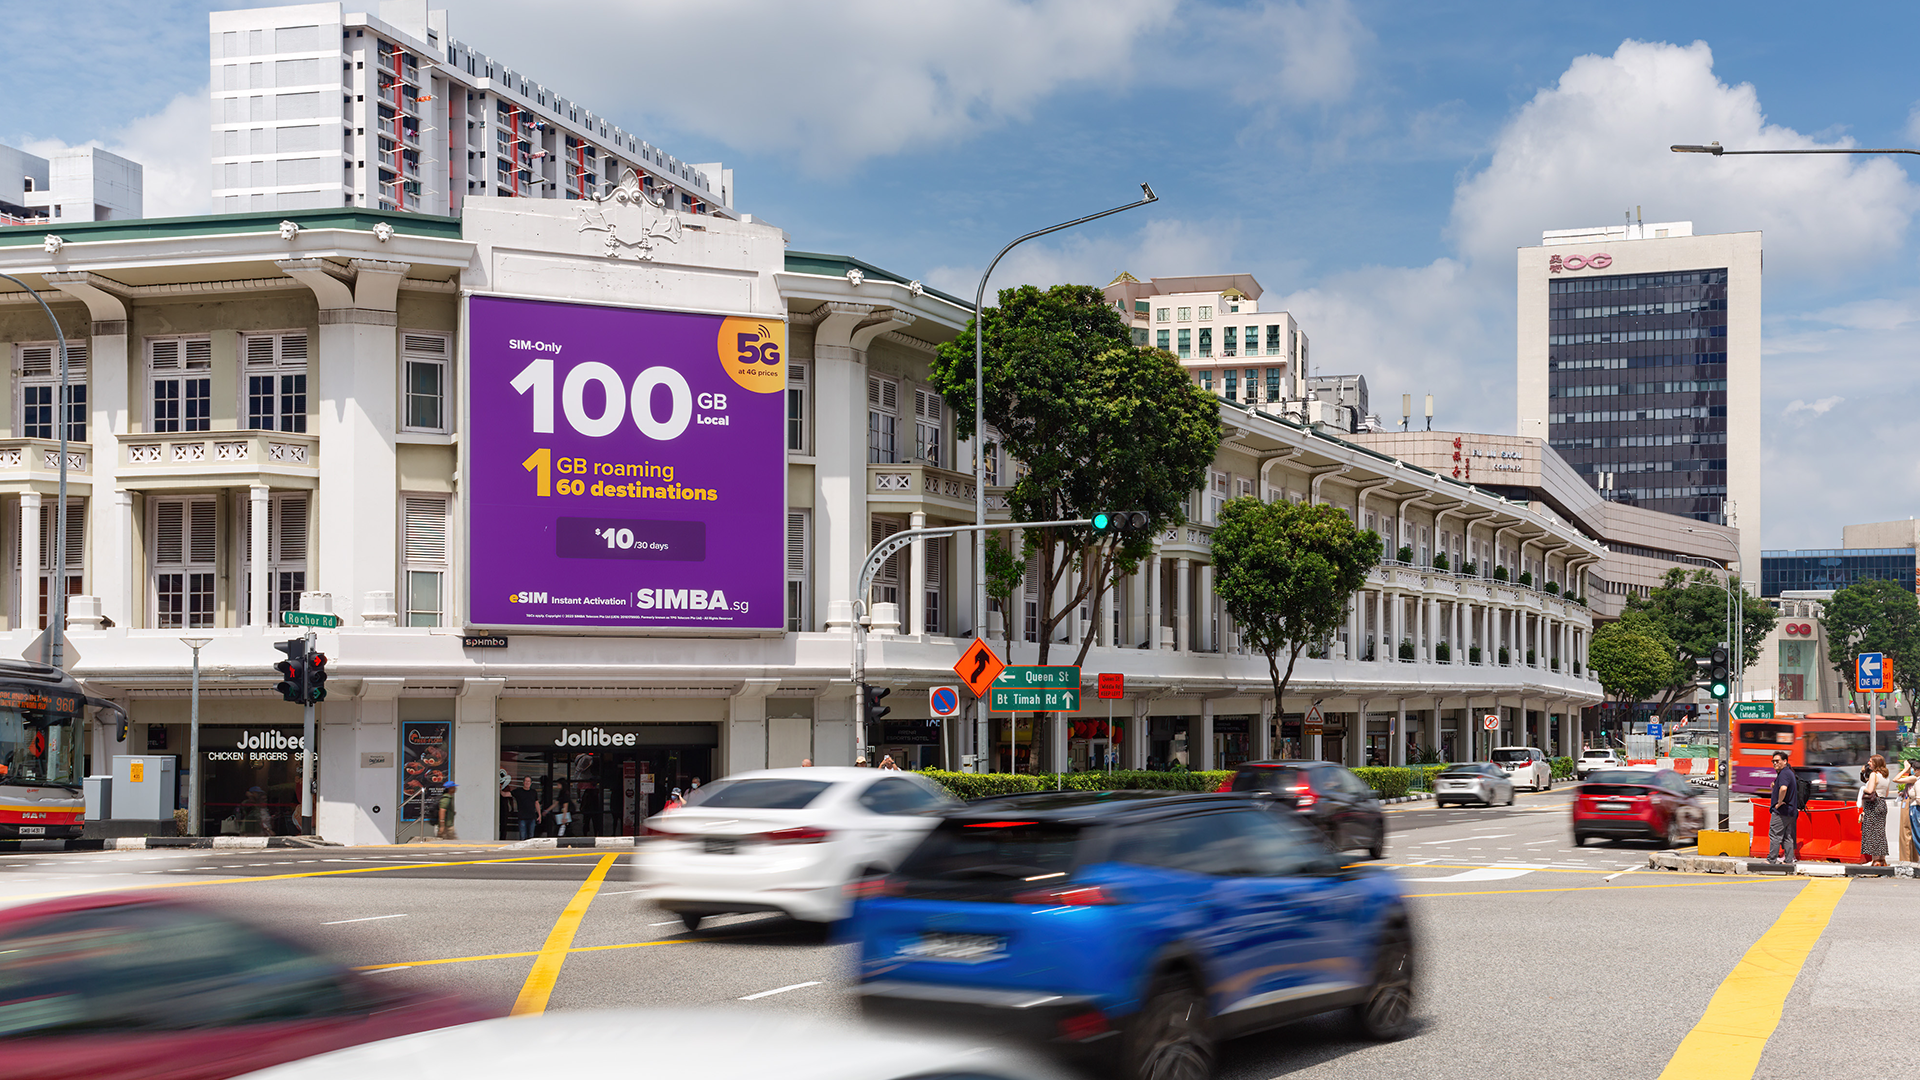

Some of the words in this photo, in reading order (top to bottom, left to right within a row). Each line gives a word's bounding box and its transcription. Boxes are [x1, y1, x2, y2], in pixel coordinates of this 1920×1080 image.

[1563, 253, 1612, 270] OG
[509, 339, 562, 354] SIM-Only
[737, 332, 780, 365] 5G
[758, 369, 778, 377] prices
[510, 358, 692, 440] 100
[697, 392, 727, 410] GB
[697, 413, 729, 426] Local
[522, 448, 551, 497] 1
[556, 457, 587, 475] GB
[594, 460, 674, 482] roaming
[556, 479, 586, 496] 60
[591, 480, 718, 501] destinations
[649, 541, 669, 551] days
[509, 591, 548, 604] eSIM
[551, 596, 581, 605] Instant
[583, 596, 626, 606] Activation
[288, 613, 320, 625] Rochor
[322, 616, 333, 626] Rd
[1026, 671, 1053, 684] Queen
[1059, 671, 1069, 682] St
[1861, 678, 1870, 686] ONE
[1871, 678, 1880, 686] WAY
[56, 697, 75, 712] 960
[997, 694, 1008, 705] Bt
[1013, 693, 1040, 705] Timah
[1045, 694, 1057, 705] Rd
[555, 727, 637, 746] Jollibee
[208, 752, 244, 760] CHICKEN
[250, 752, 288, 761] BURGERS
